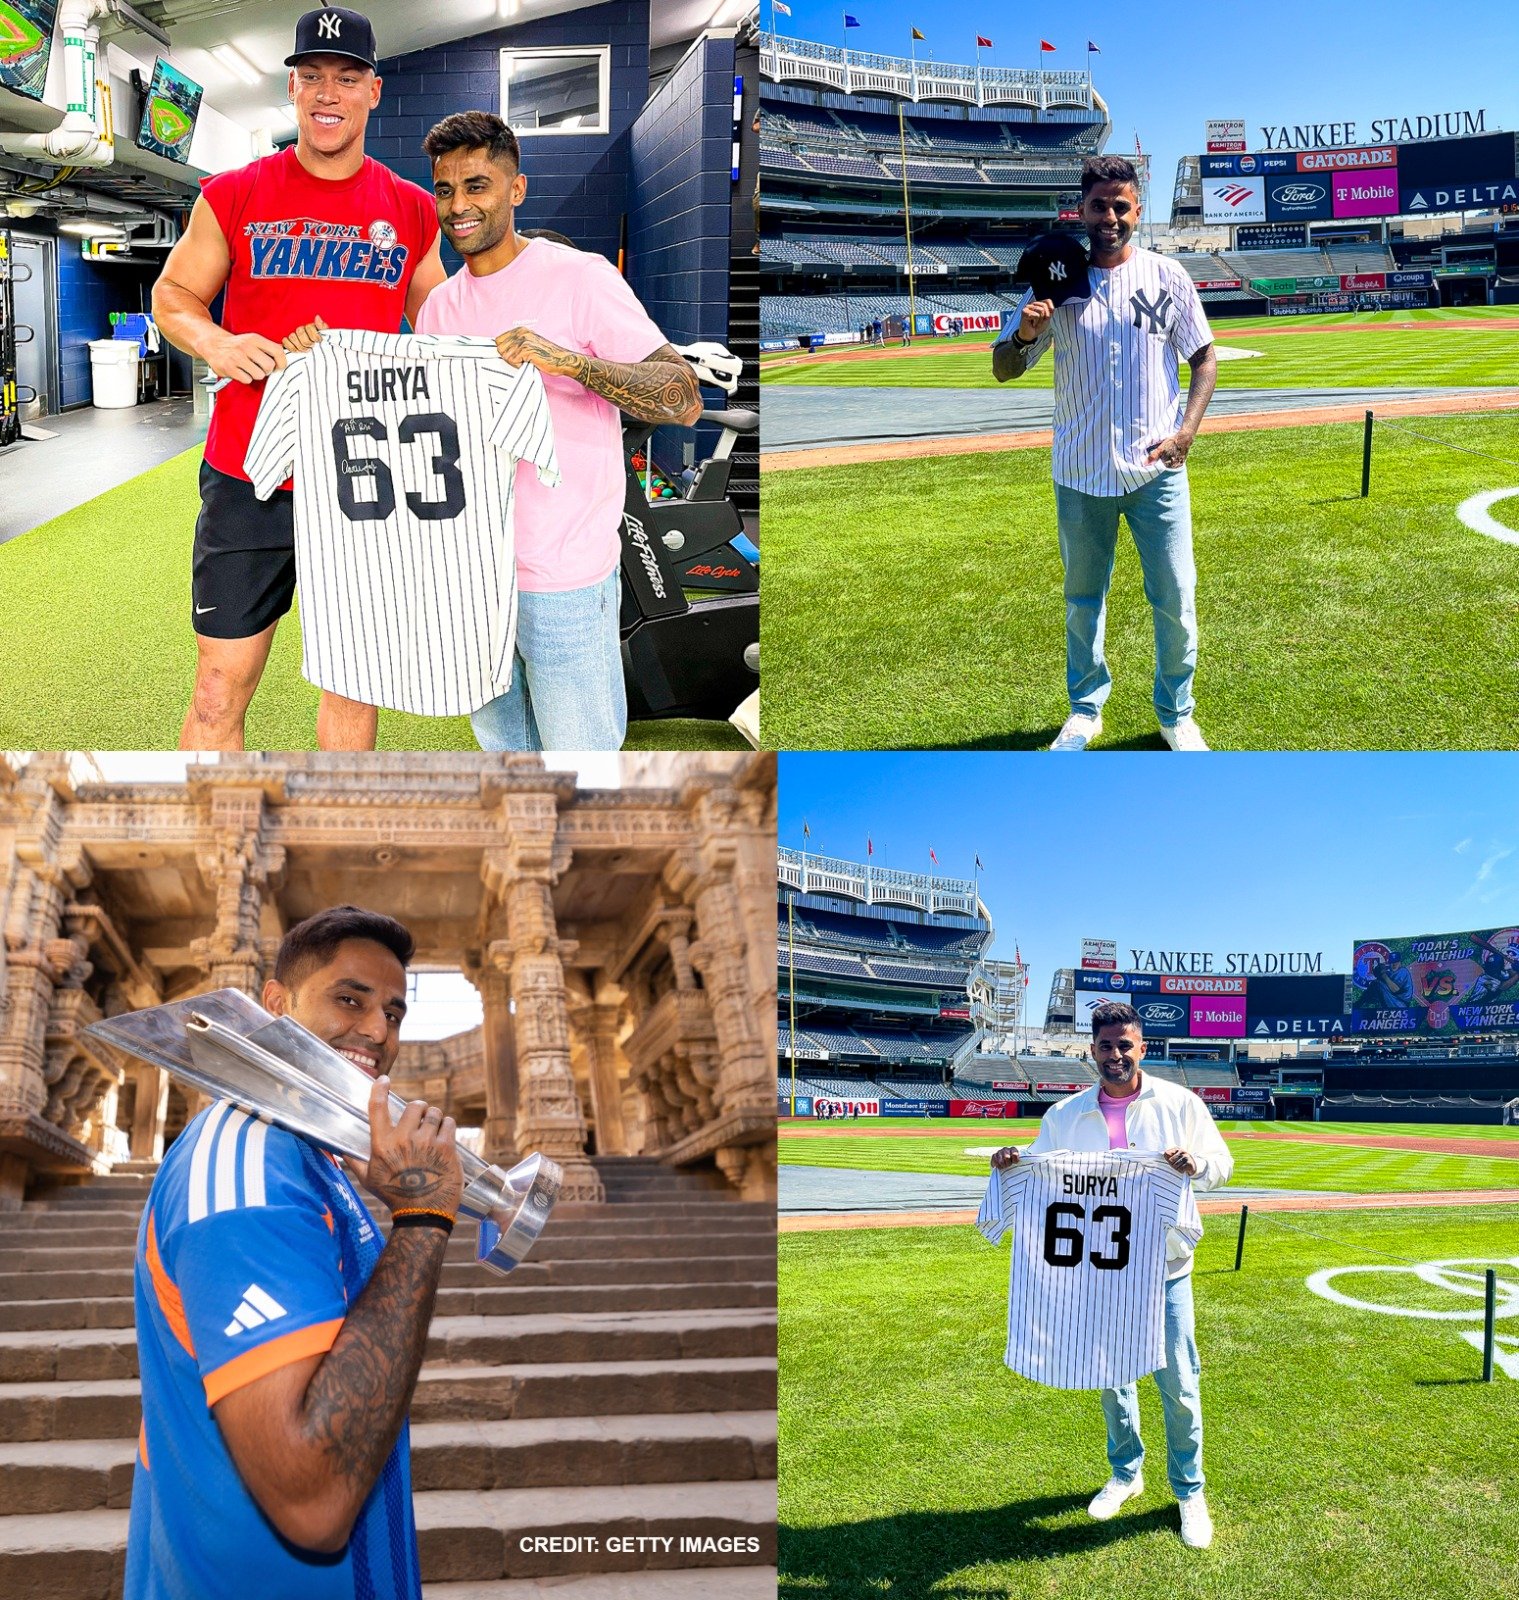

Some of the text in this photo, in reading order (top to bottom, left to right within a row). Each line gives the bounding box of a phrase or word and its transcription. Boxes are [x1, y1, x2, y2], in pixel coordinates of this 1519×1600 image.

[1260, 108, 1486, 150] YANKEE STADIUM
[1302, 150, 1392, 169] GATORADE
[1281, 186, 1316, 201] Ford
[1350, 186, 1394, 200] Mobile
[1436, 185, 1517, 206] DELTA
[244, 221, 362, 238] NEW YORK
[251, 236, 408, 285] YANKEES
[911, 265, 939, 274] ORIS
[1402, 273, 1425, 282] coupa
[347, 366, 430, 403] SURYA
[332, 412, 466, 521] 63
[1411, 939, 1459, 952] TODAY'S
[1130, 949, 1322, 974] YANKEE STADIUM
[1417, 948, 1474, 963] MATCHUP
[1083, 976, 1104, 984] PEPSI
[1131, 979, 1152, 987] PEPSI
[1165, 978, 1243, 992] GATORADE
[1421, 973, 1459, 997] VS.
[1145, 1005, 1176, 1020] Ford
[1205, 1011, 1243, 1023] Mobile
[1376, 1010, 1409, 1019] TEXAS
[1458, 1004, 1513, 1016] NEW YORK
[1276, 1019, 1344, 1033] DELTA
[1359, 1018, 1416, 1030] RANGERS
[793, 1051, 821, 1059] ORIS
[1063, 1174, 1117, 1197] SURYA
[1043, 1201, 1132, 1270] 63
